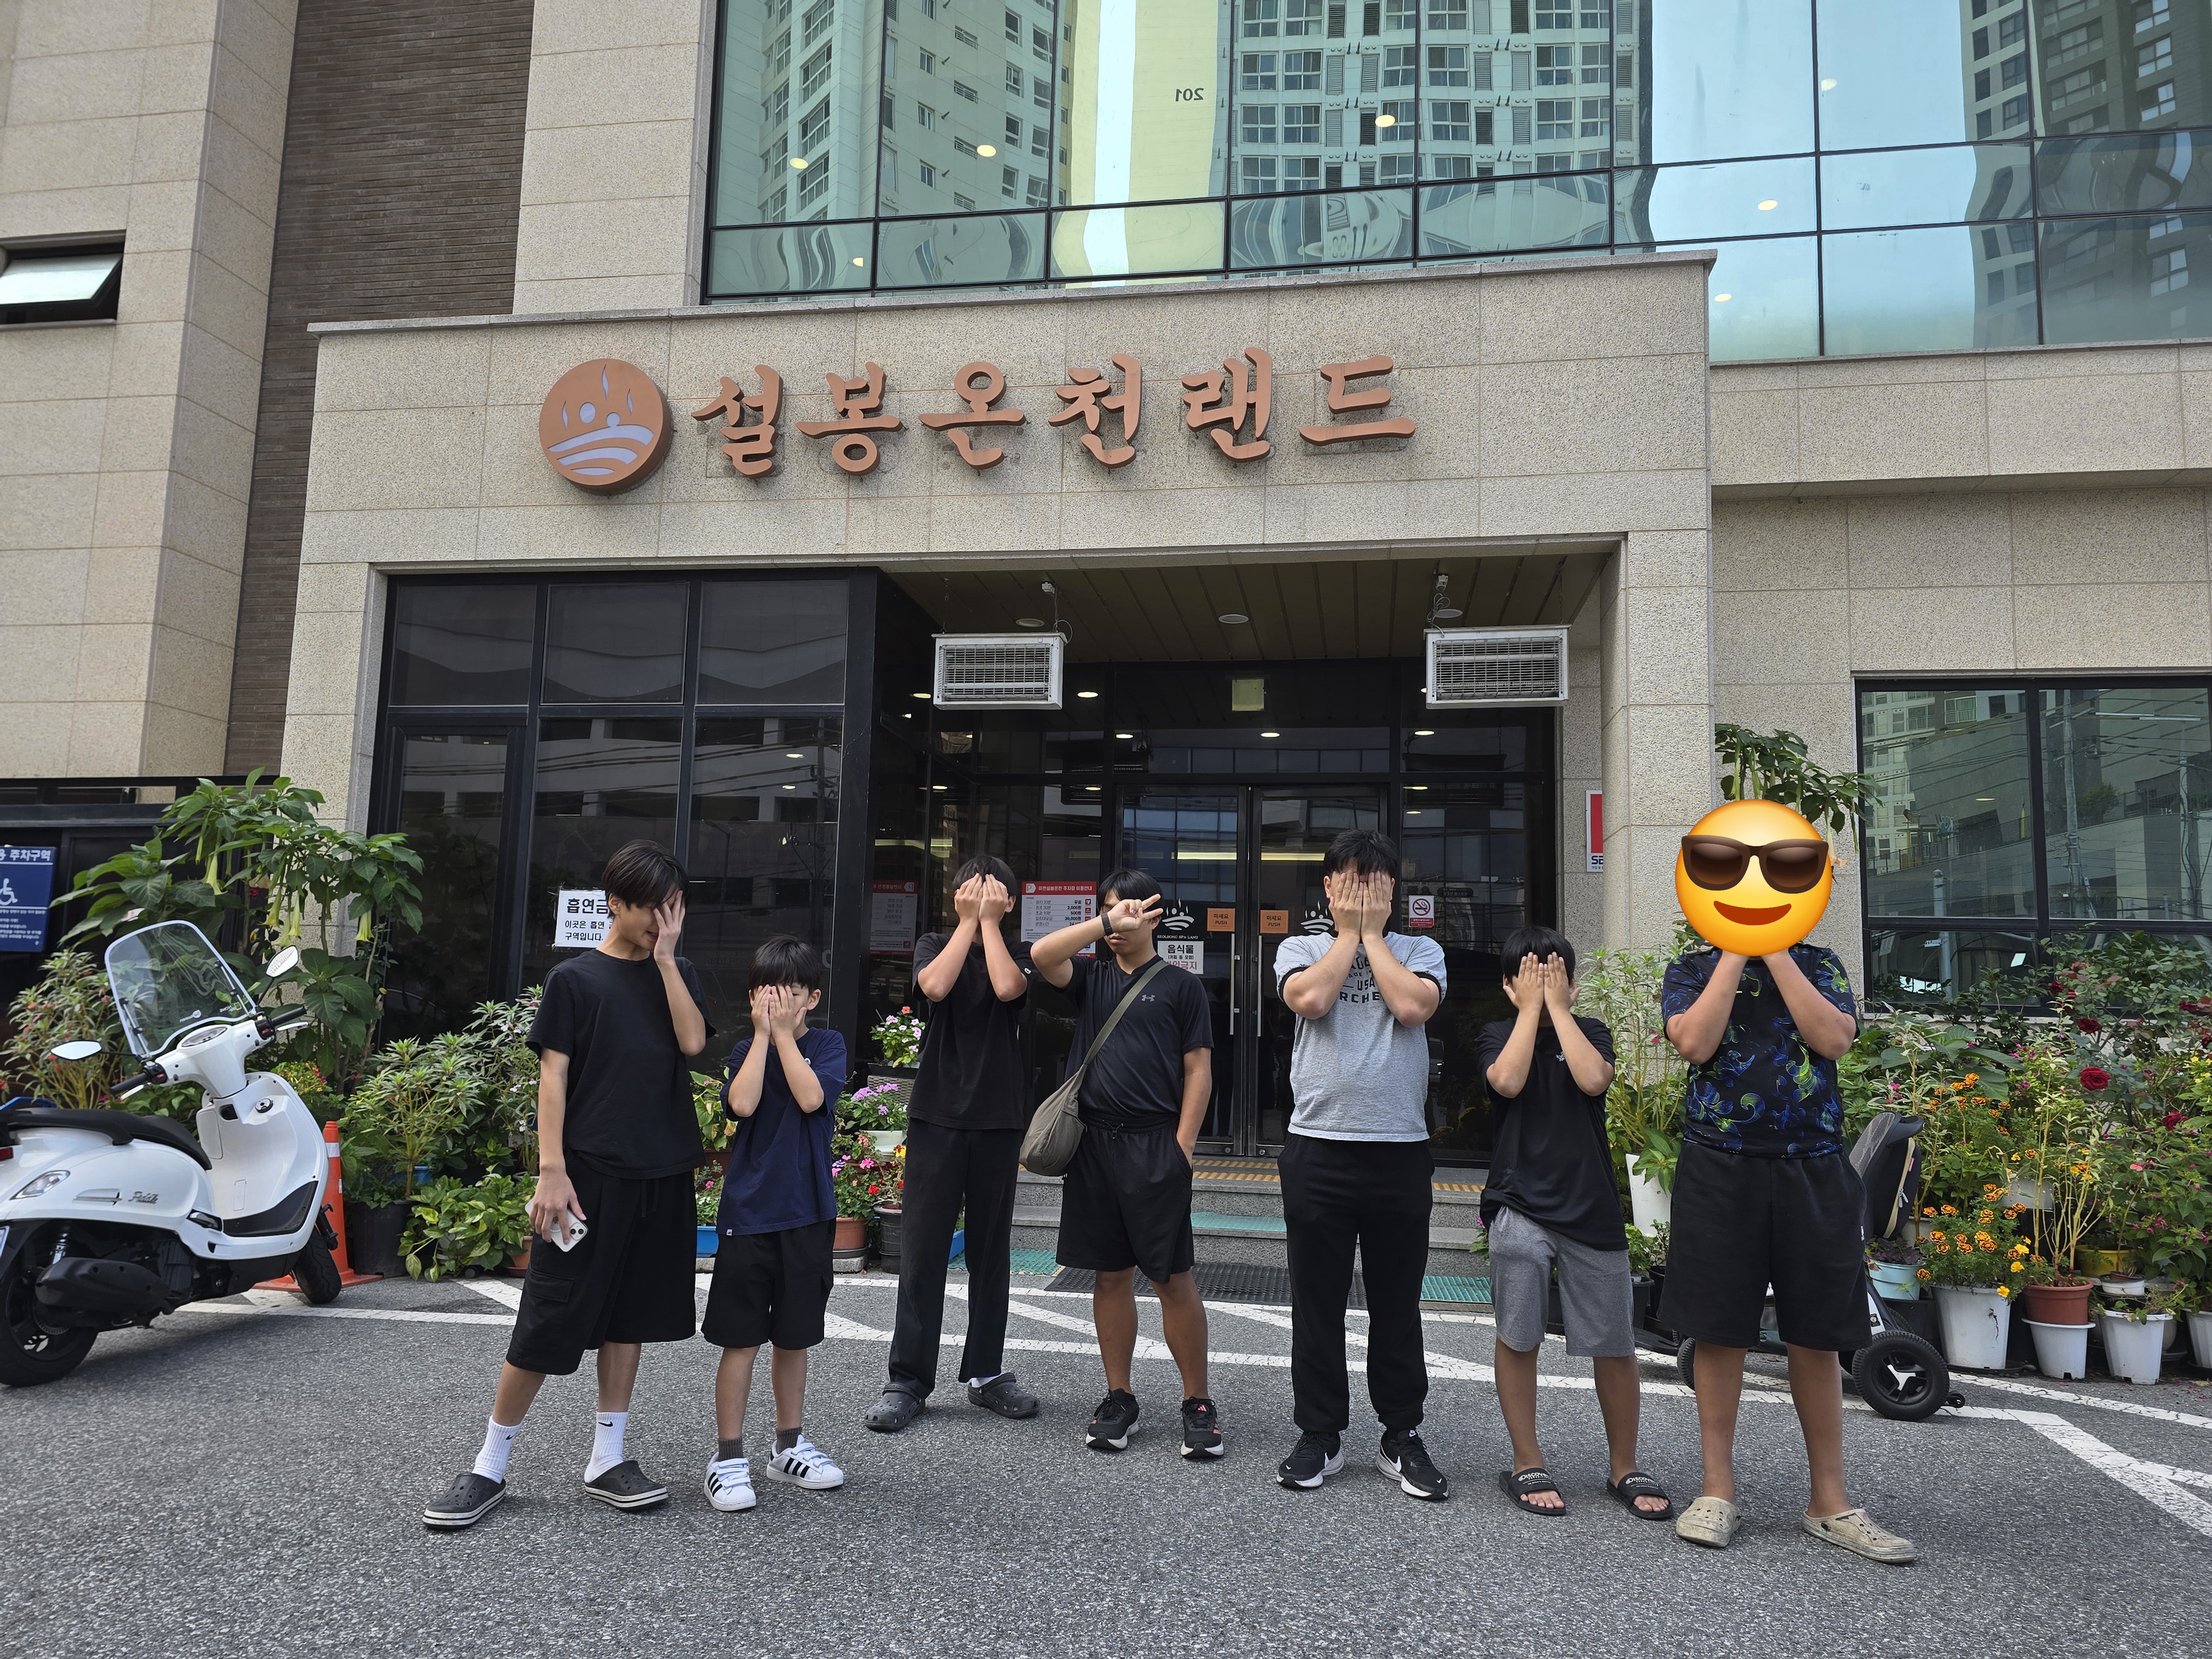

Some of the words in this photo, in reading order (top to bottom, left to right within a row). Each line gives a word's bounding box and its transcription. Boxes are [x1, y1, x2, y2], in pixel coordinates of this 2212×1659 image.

[691, 348, 1416, 479] 설봉온천랜드
[9, 849, 51, 861] 주차구역
[1592, 855, 1604, 864] SE
[567, 898, 608, 914] 흡연금
[565, 920, 586, 928] 이곳은
[591, 921, 604, 929] 흡연
[565, 932, 603, 941] 구역입니다.
[1167, 945, 1194, 954] 음식물
[1358, 977, 1375, 991] USA
[1339, 991, 1380, 1004] RCHE
